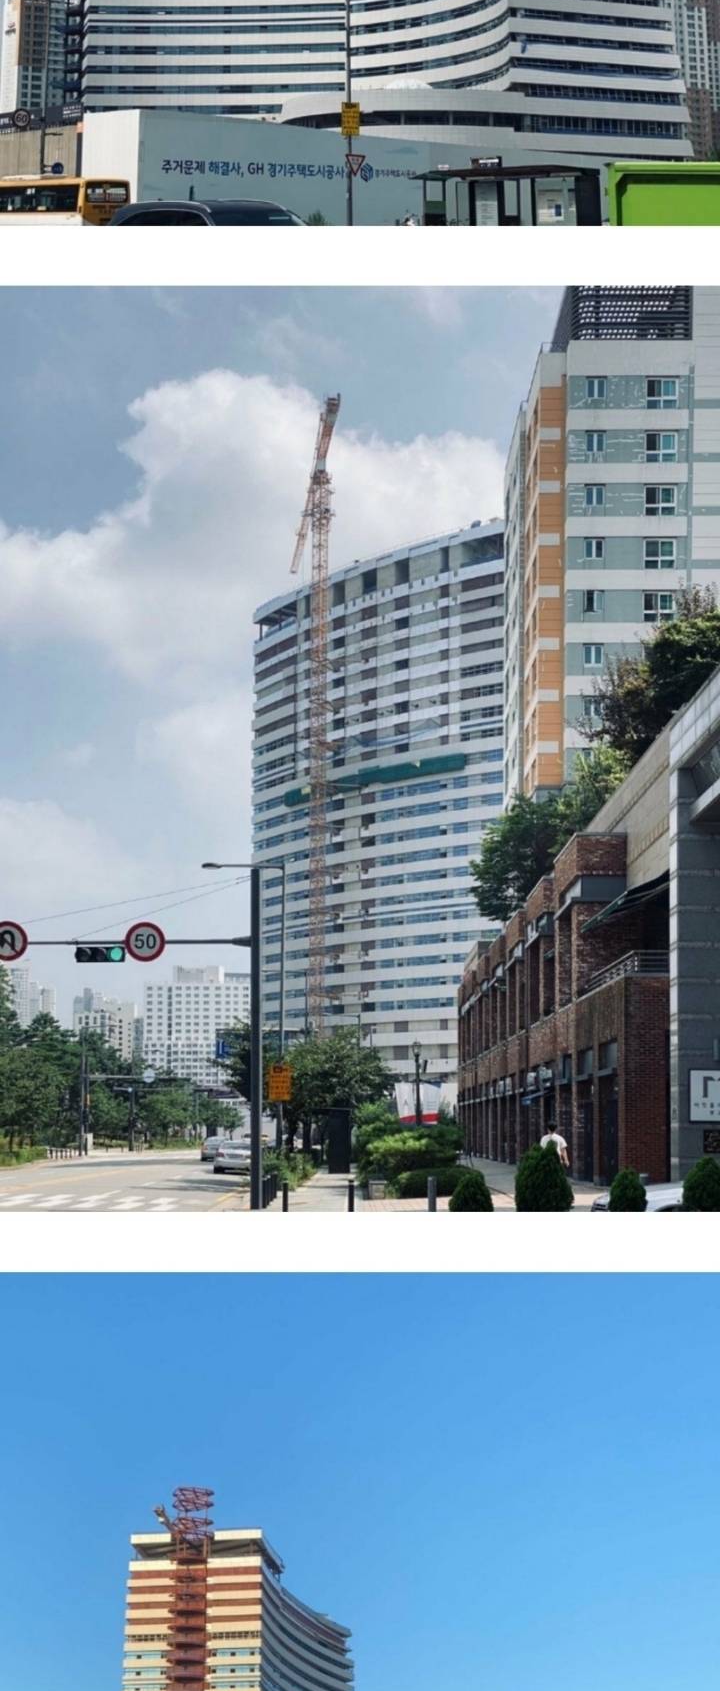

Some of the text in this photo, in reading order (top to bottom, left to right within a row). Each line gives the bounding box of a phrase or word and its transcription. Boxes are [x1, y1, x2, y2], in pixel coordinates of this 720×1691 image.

[161, 160, 345, 180] 주거문제 해결사, GH 경기주택도시공사
[134, 933, 157, 950] 50
